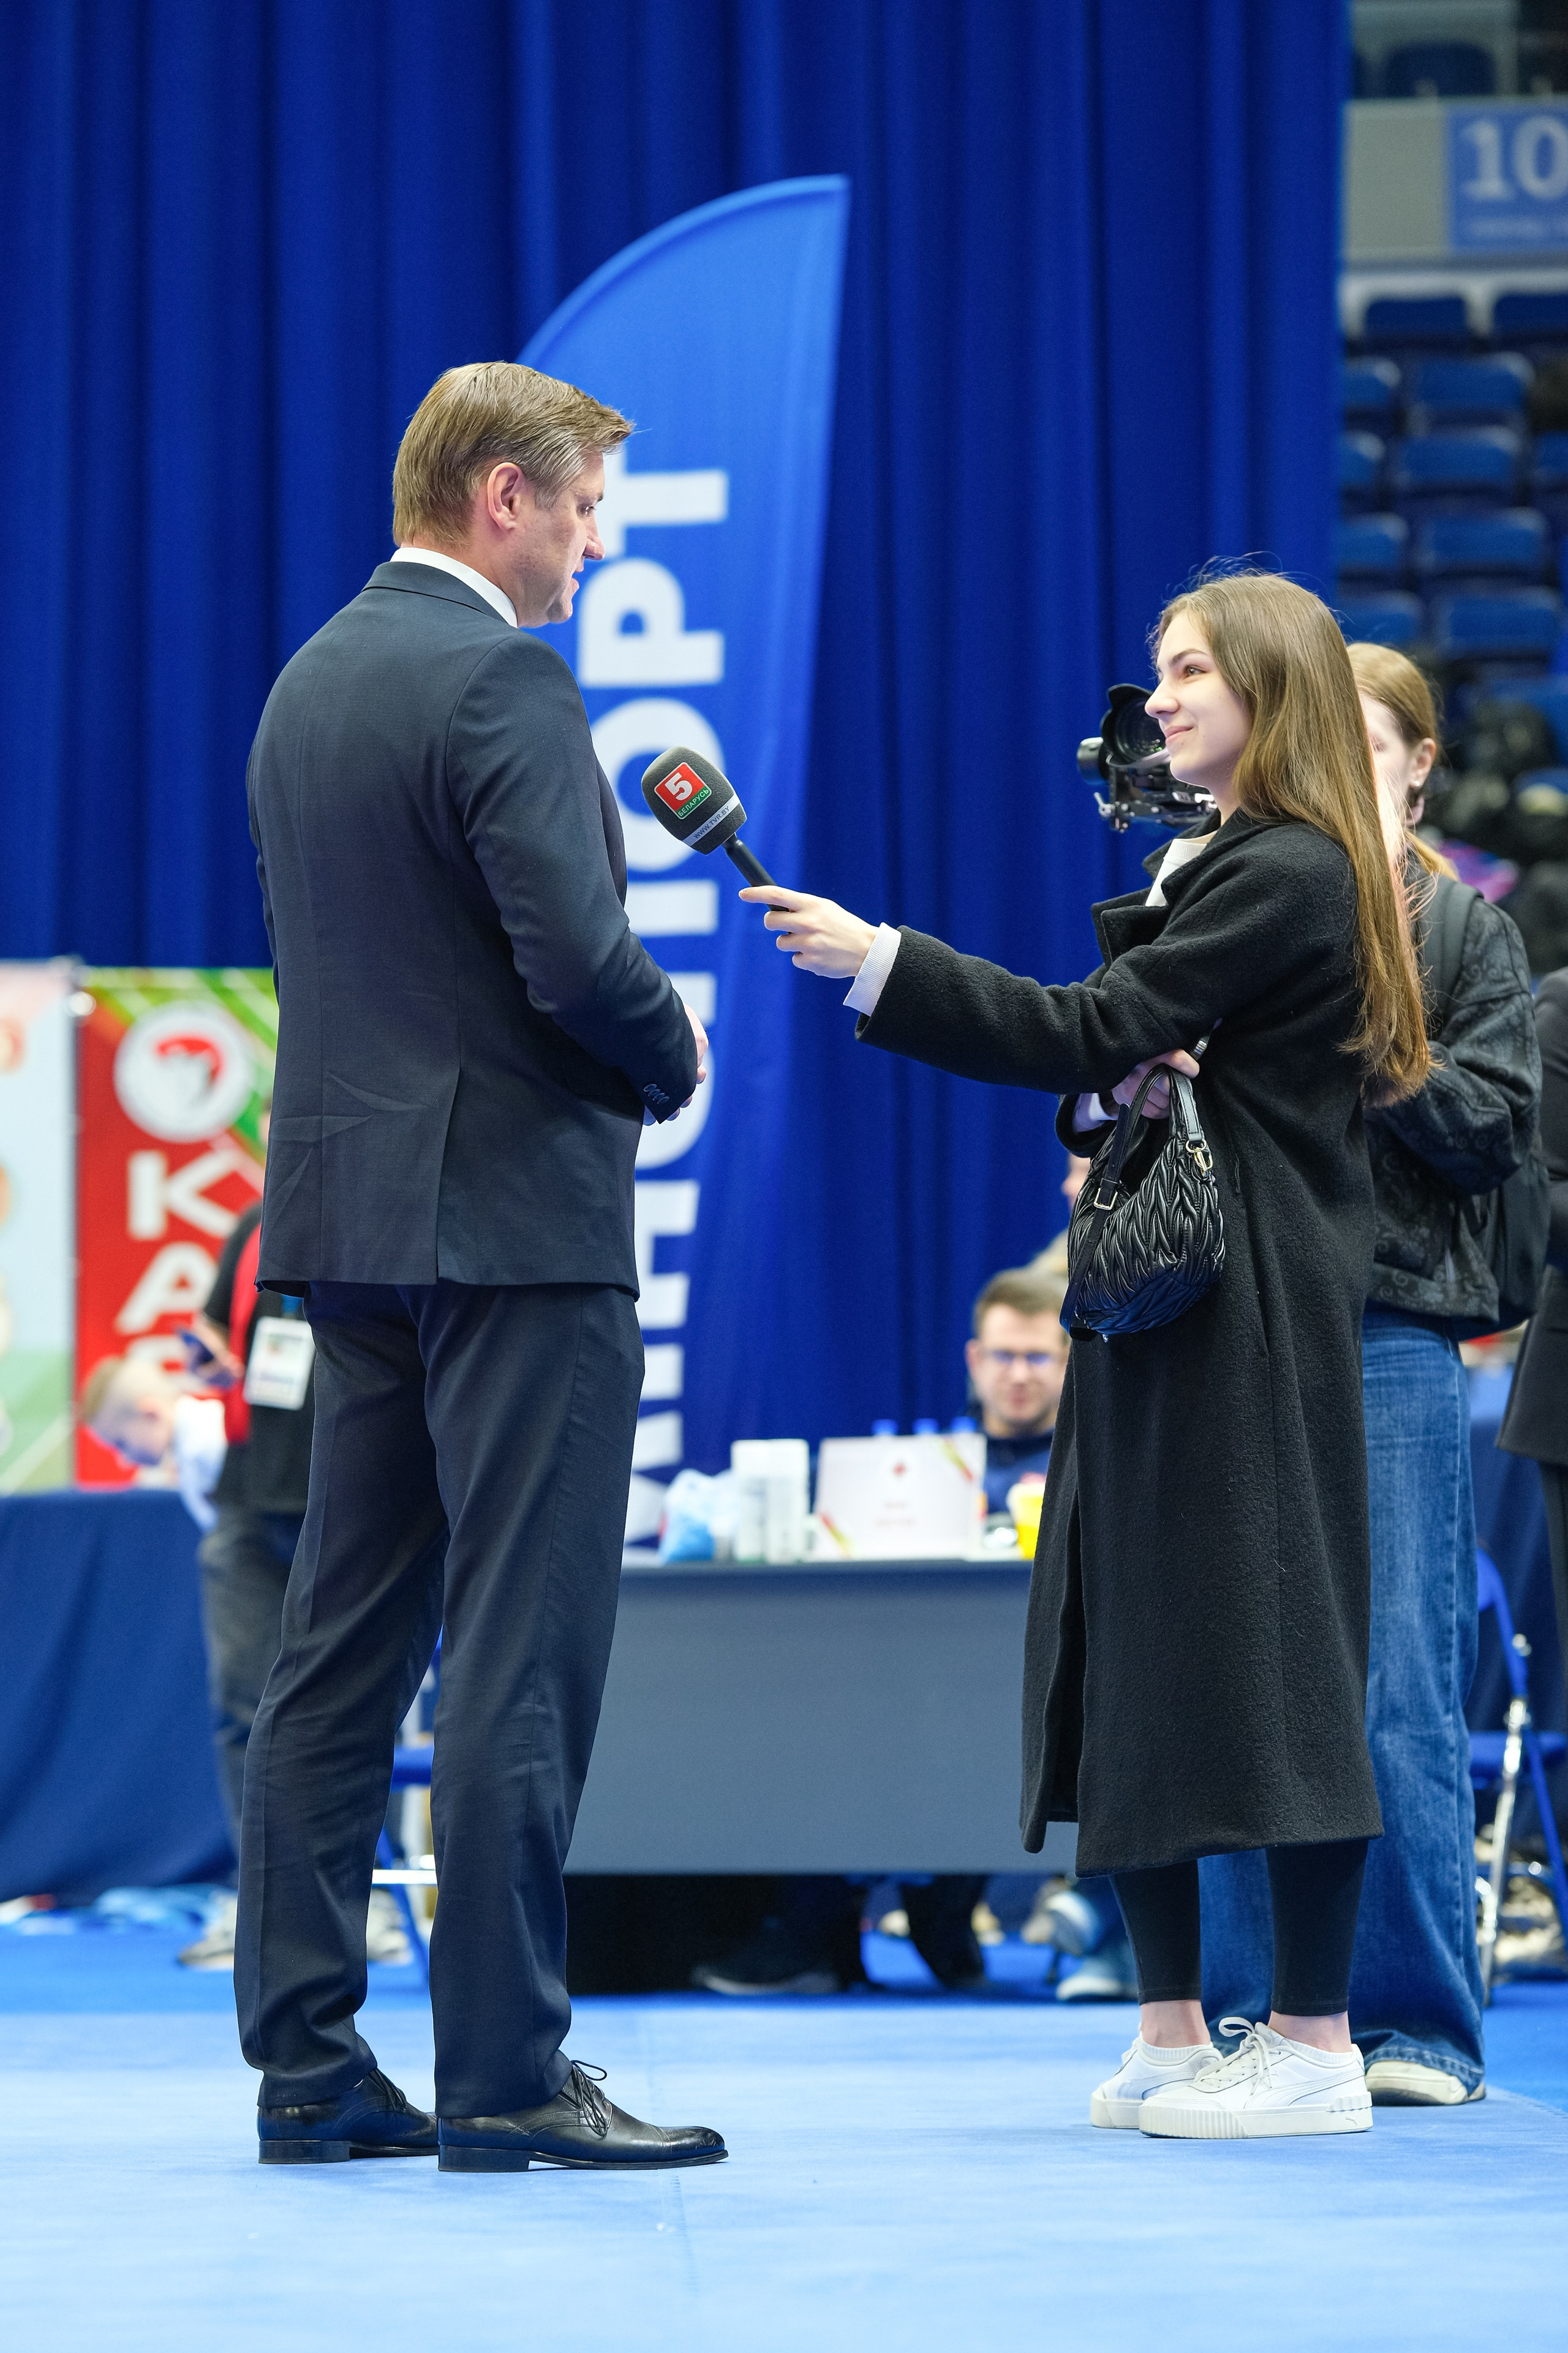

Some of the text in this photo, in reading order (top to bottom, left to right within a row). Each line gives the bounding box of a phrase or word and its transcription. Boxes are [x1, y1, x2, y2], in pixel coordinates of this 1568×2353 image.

[665, 772, 693, 801] 5
[677, 788, 709, 817] БЕЛАРУСЬ
[693, 806, 730, 839] WWW.TVR.BY
